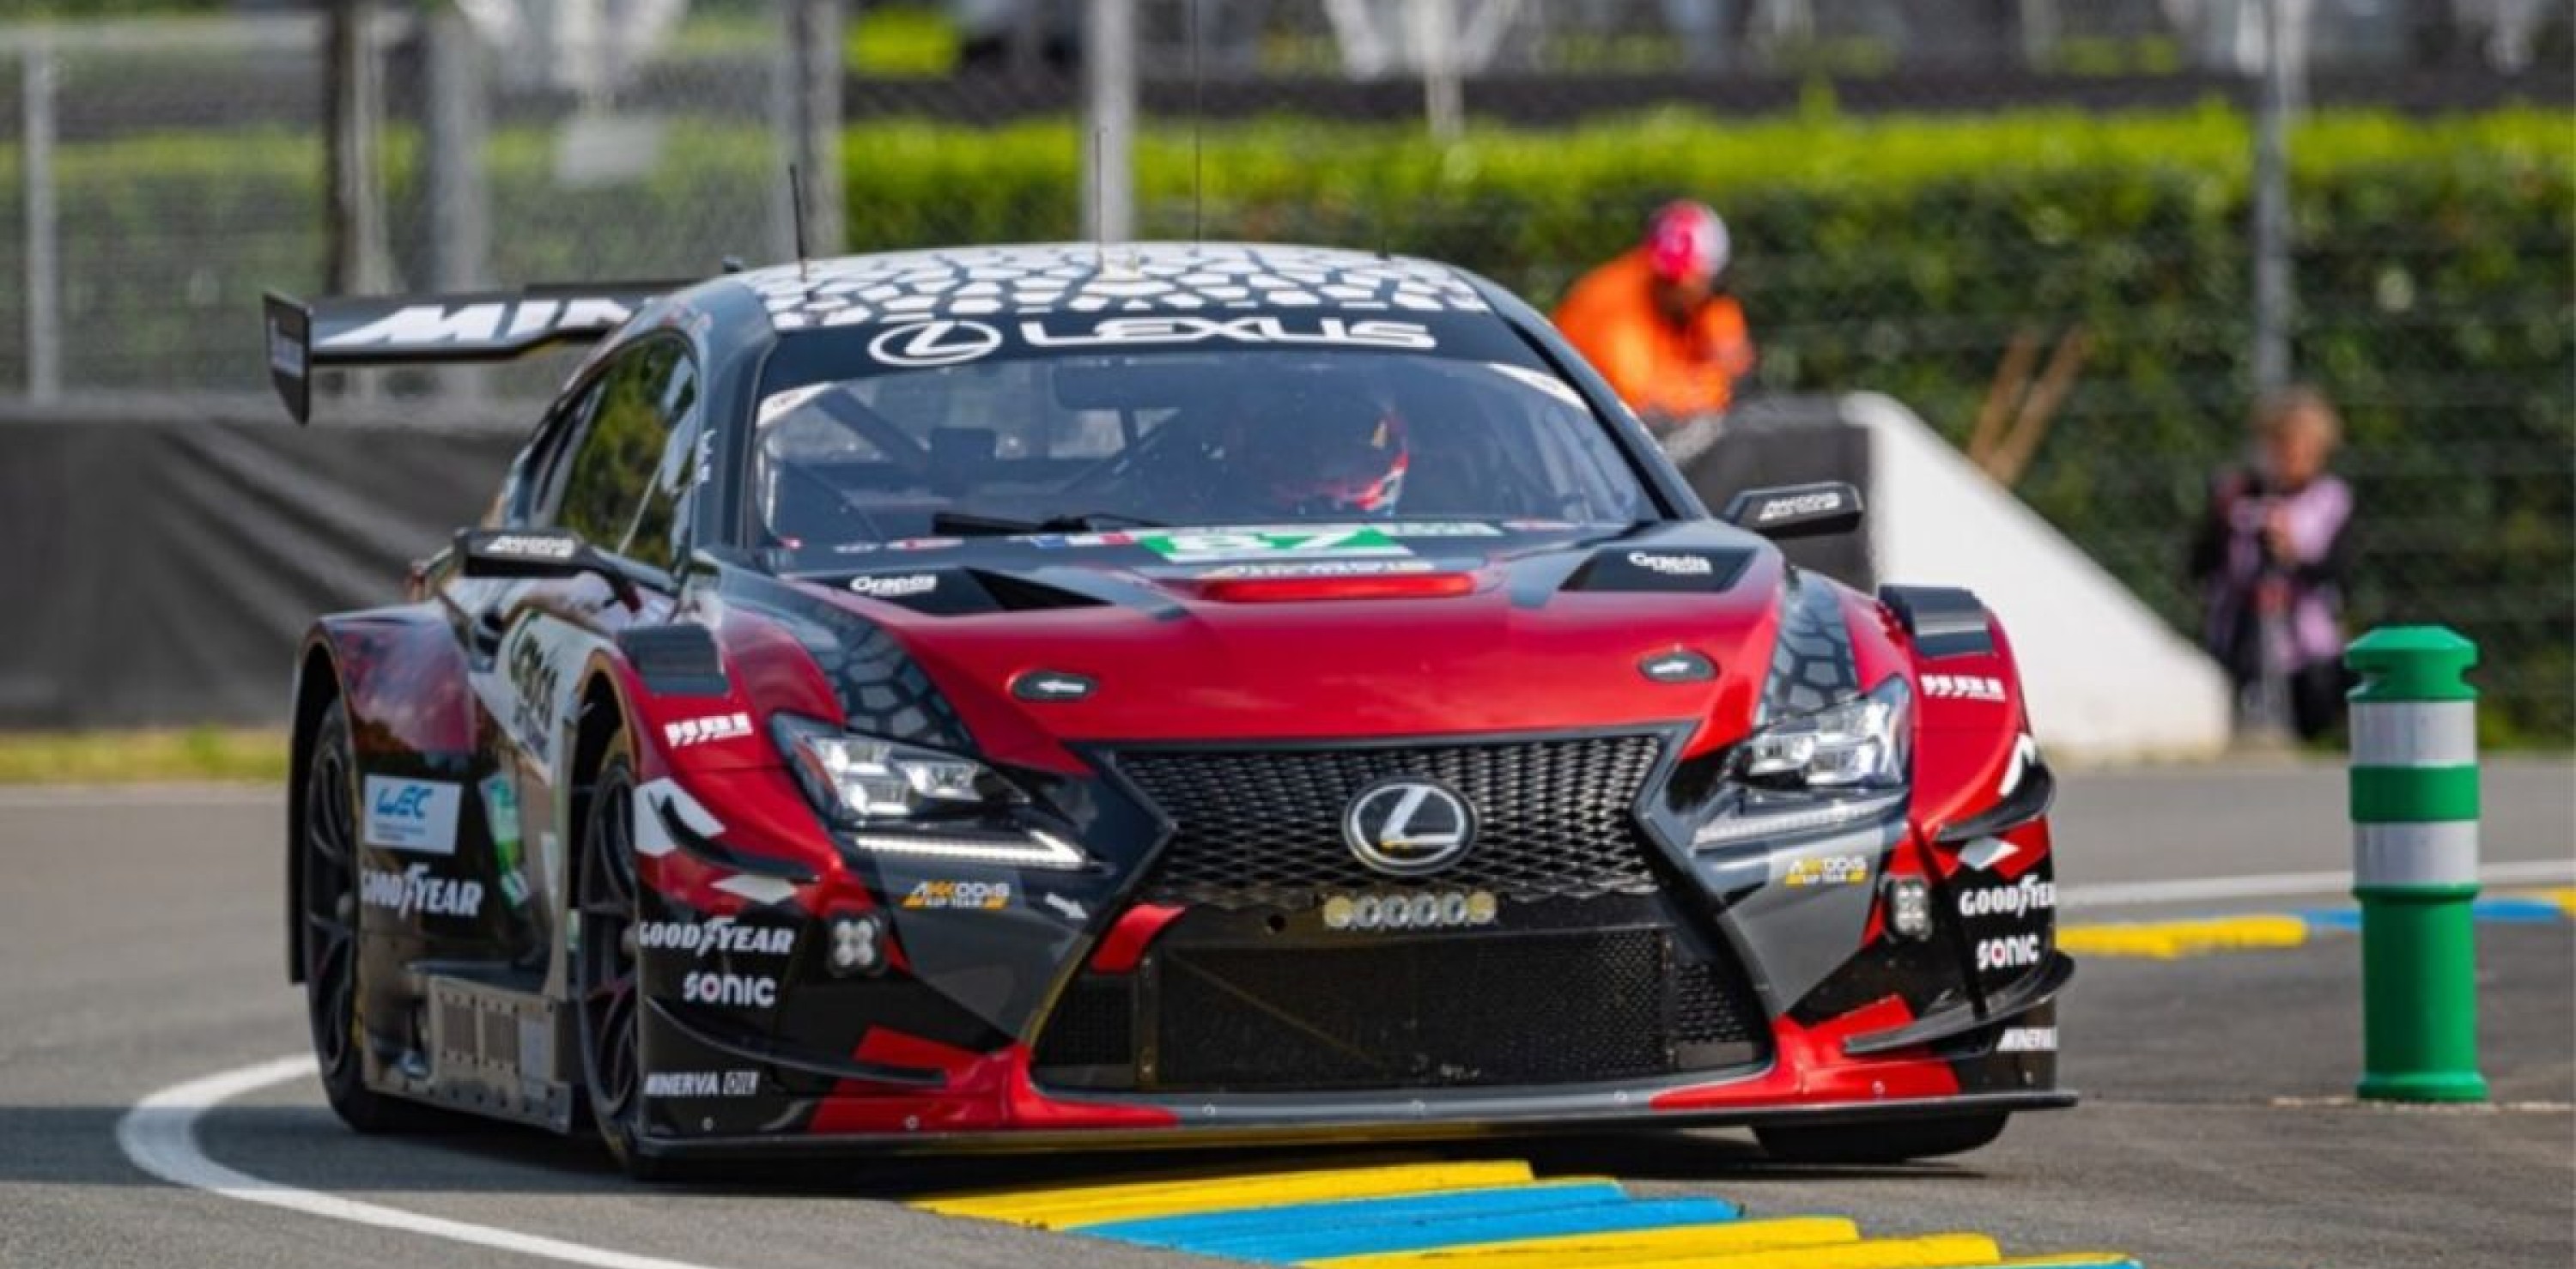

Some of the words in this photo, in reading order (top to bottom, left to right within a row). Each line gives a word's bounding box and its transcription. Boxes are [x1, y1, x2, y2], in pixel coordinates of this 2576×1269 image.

[1021, 317, 1436, 348] LEXUS
[1170, 531, 1358, 550] 87
[375, 783, 434, 819] WEC
